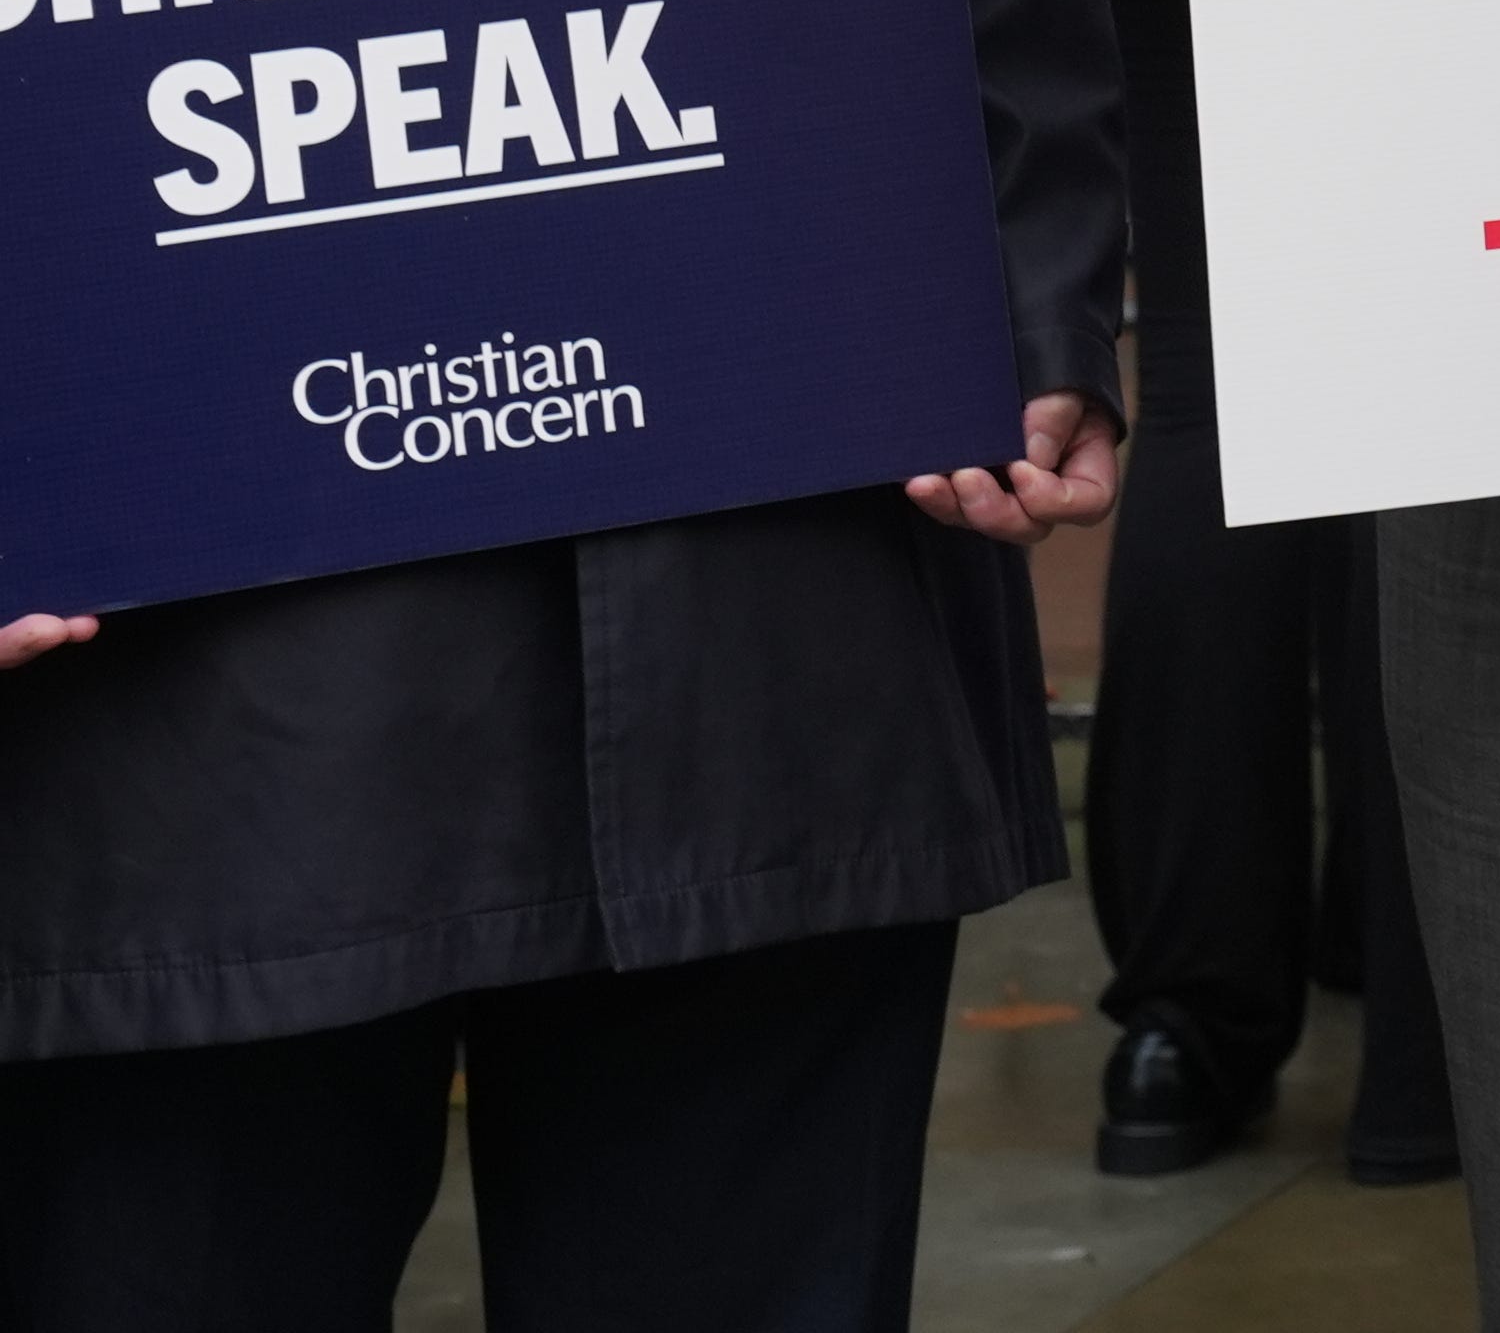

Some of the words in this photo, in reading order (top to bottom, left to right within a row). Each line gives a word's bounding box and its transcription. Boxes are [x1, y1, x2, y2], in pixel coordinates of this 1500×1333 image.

[146, 0, 717, 216] SPEAK.
[291, 331, 606, 424] Christian
[343, 384, 645, 471] Concern
